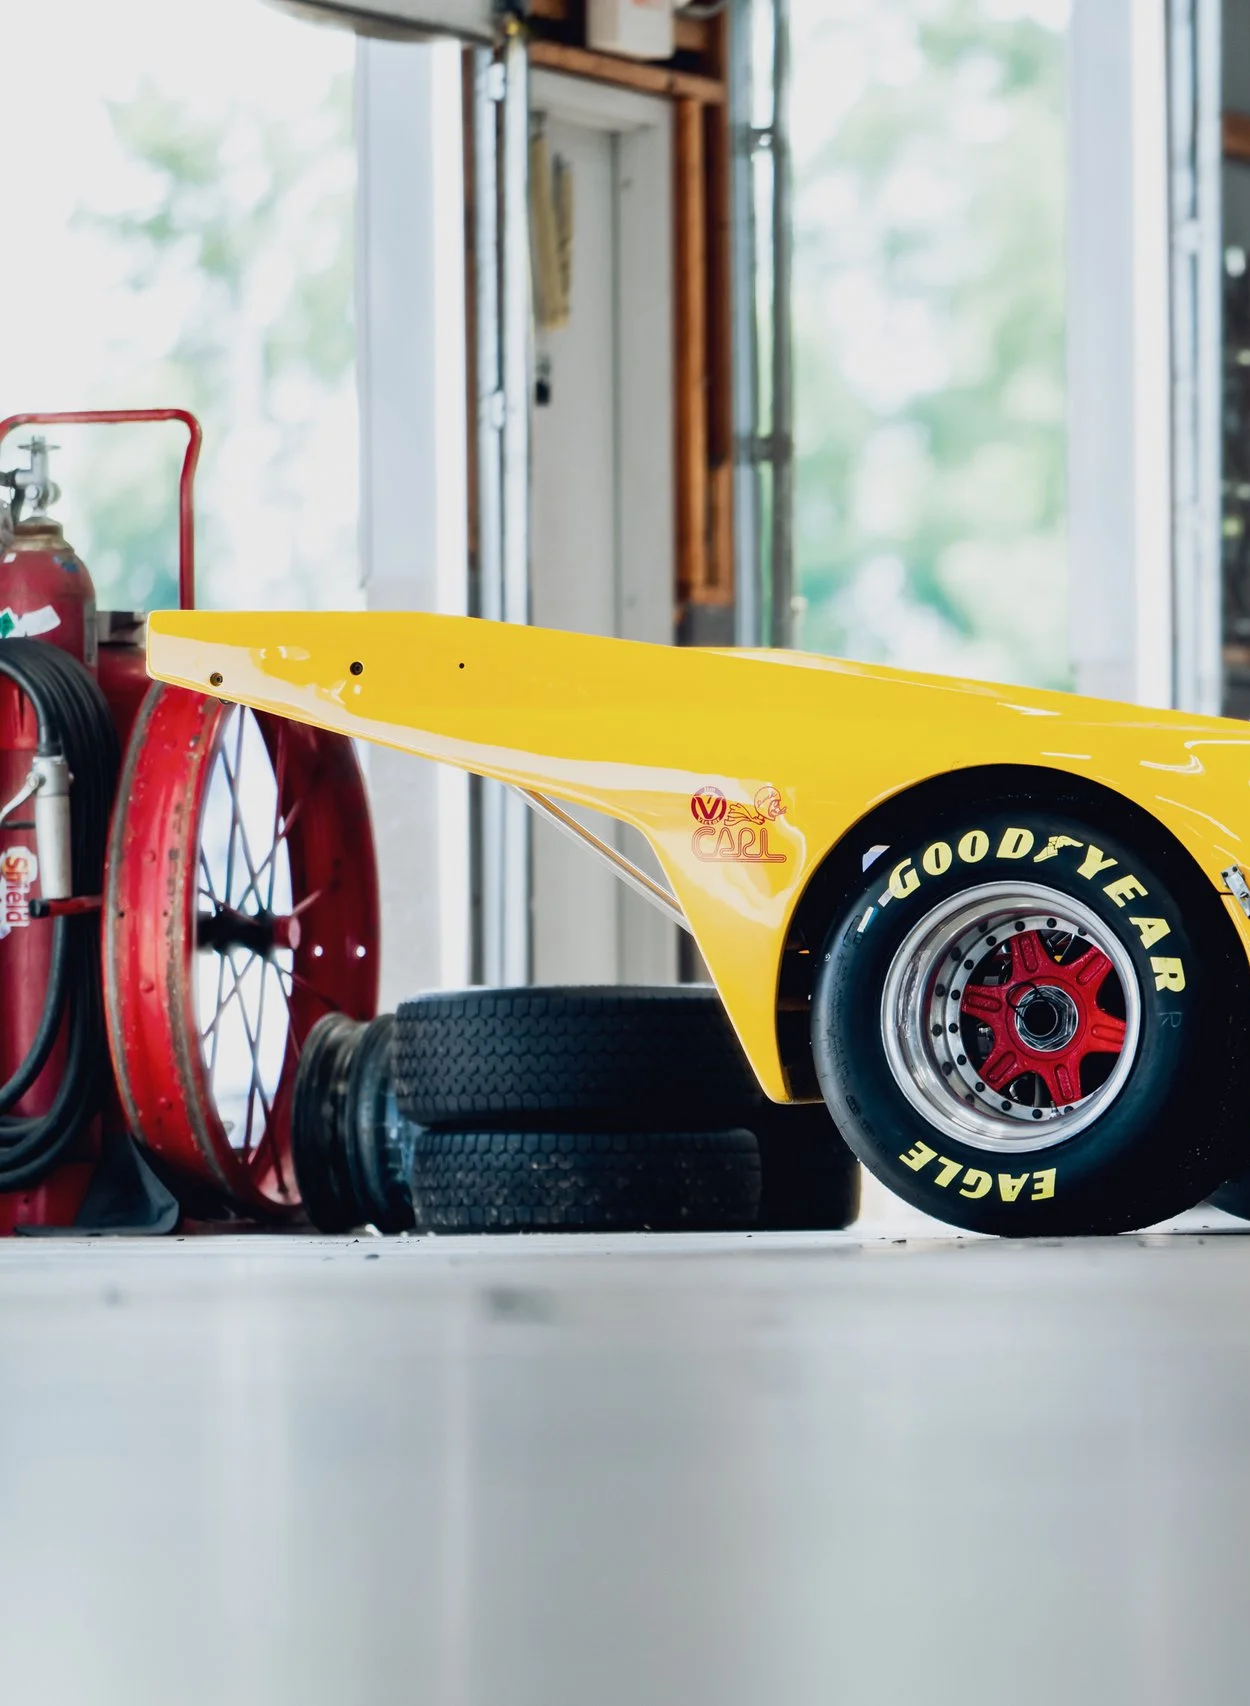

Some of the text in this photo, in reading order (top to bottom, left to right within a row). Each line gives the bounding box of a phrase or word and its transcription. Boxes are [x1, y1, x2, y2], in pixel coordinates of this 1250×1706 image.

[691, 826, 788, 864] CARL
[888, 827, 1186, 993] GOODYEAR
[899, 1141, 1057, 1202] EAGLE
